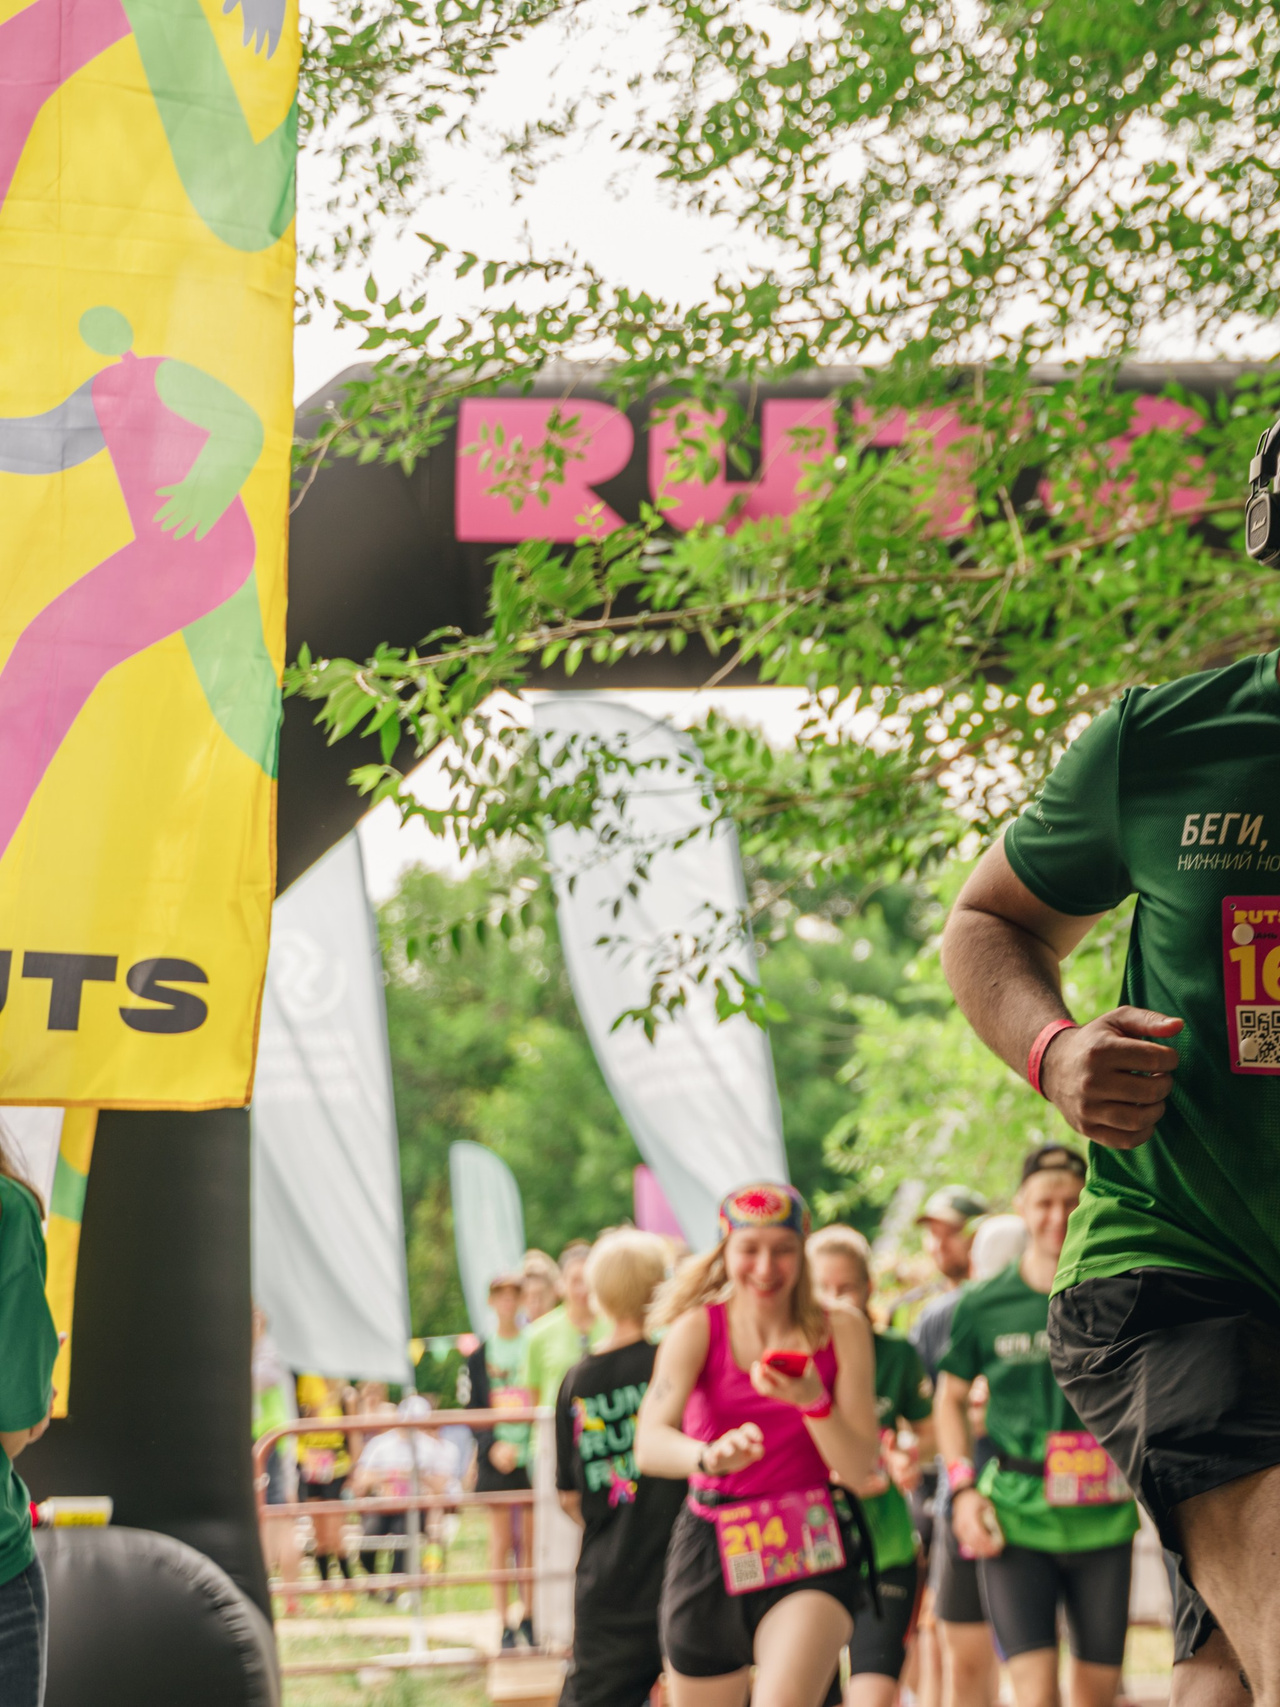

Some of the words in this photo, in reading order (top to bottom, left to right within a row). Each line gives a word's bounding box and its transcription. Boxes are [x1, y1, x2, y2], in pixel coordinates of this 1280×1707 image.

[1180, 812, 1269, 852] БЕГИ,
[1177, 851, 1254, 871] НИЖНИЙ
[722, 1516, 789, 1557] 214
